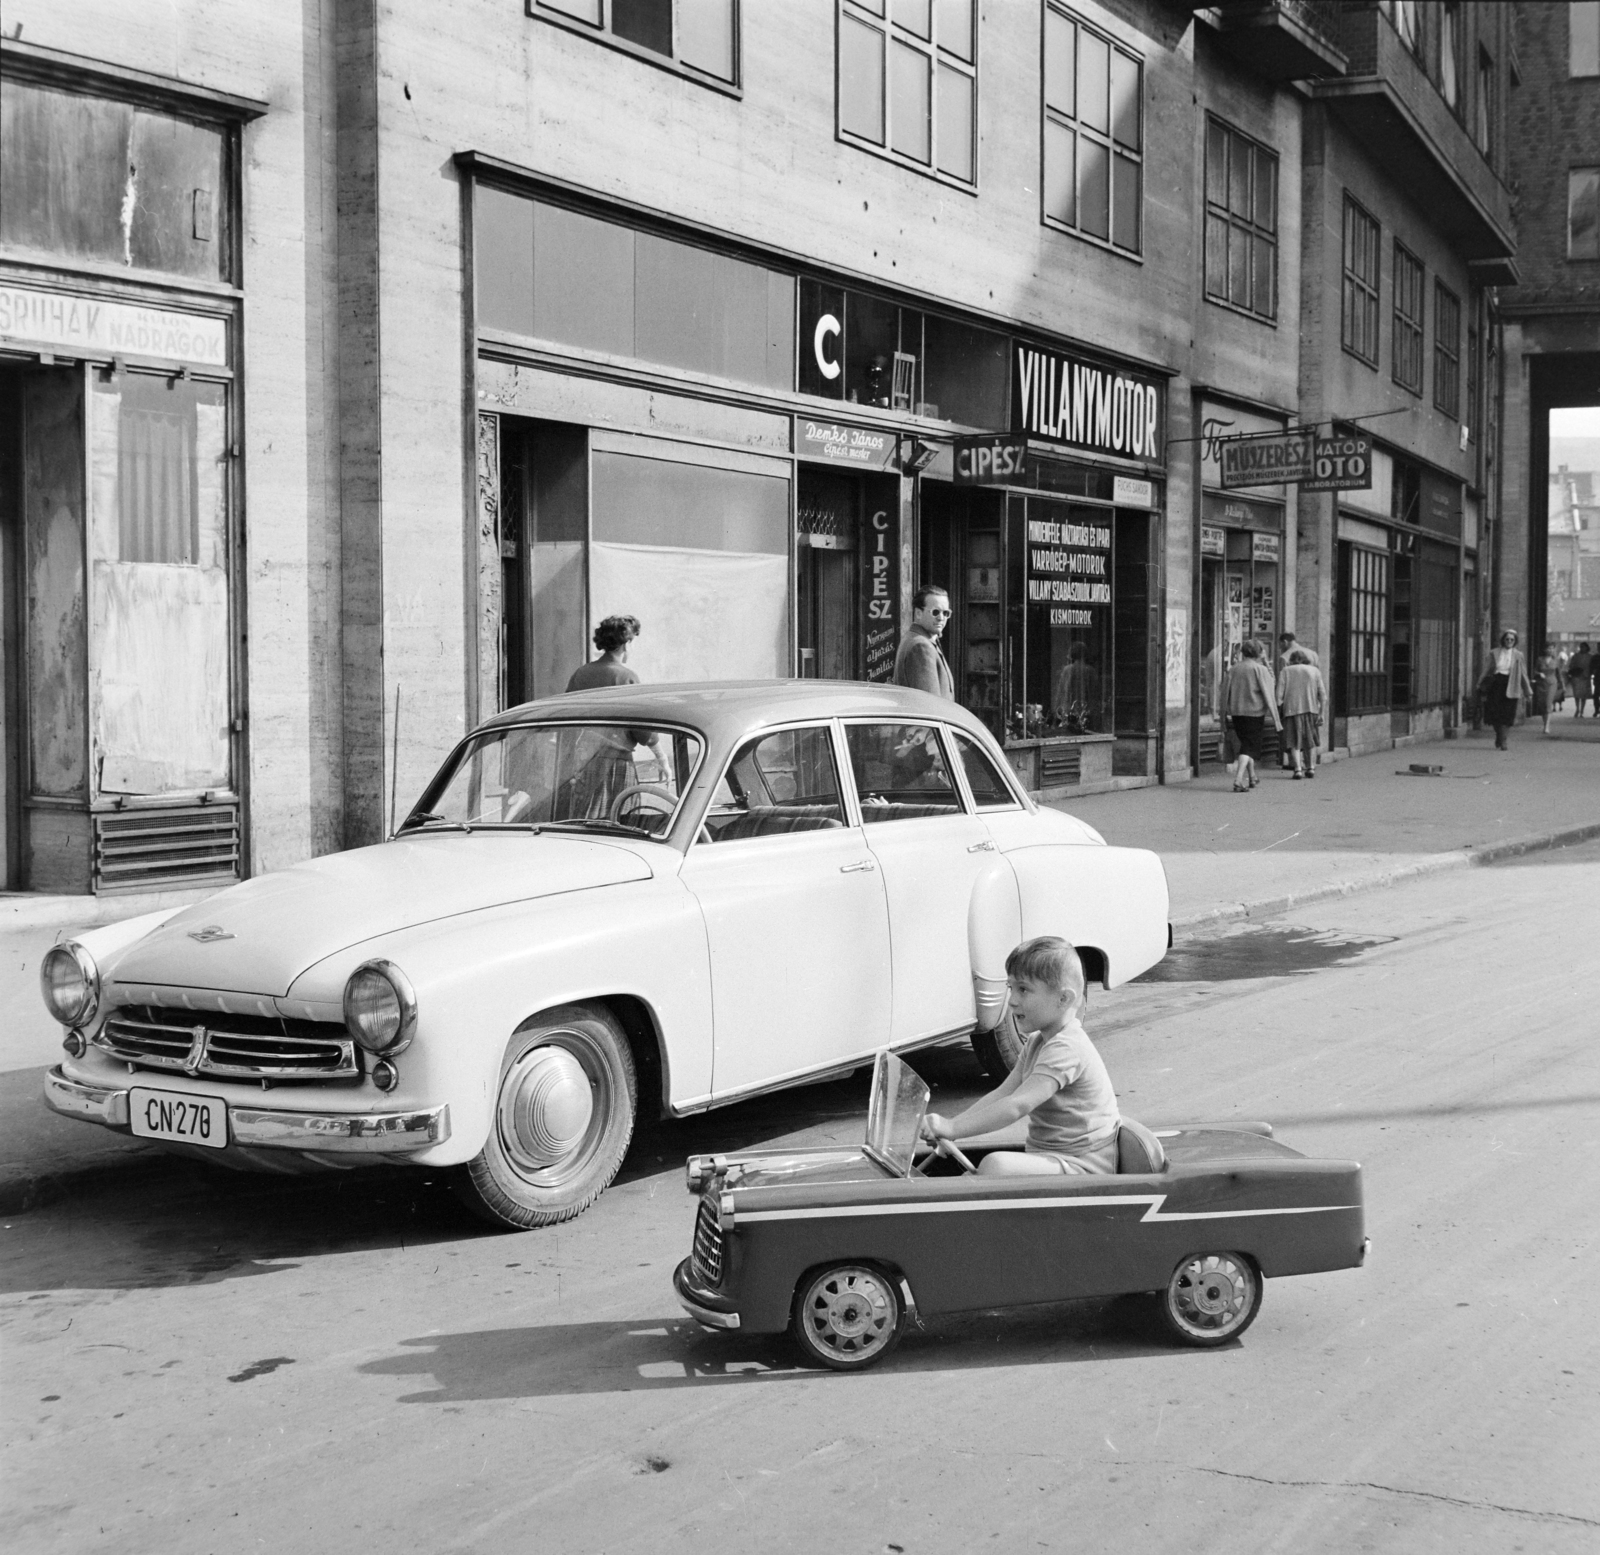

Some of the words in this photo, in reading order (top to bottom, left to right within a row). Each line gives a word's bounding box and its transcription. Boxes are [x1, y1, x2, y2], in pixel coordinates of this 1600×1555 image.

[813, 313, 842, 380] C
[1017, 347, 1157, 458] VILLANYMOTOR
[805, 422, 848, 443] Demkó
[851, 430, 884, 448] János
[1316, 440, 1367, 456] MATŐR
[956, 439, 1025, 477] CIPÉSZ
[1225, 438, 1311, 472] MŰSZERÉSZ
[1316, 456, 1365, 478] OTO
[1304, 479, 1365, 488] LABORATORIUM
[1028, 517, 1060, 544] MINDENFÉLE
[1089, 523, 1096, 547] ÉS
[1096, 528, 1110, 548] IPARI
[1031, 547, 1106, 575] VARRÓGÉP-MOTOROK
[1028, 579, 1052, 600] VILLANY
[1050, 608, 1092, 625] KISMOTOROK
